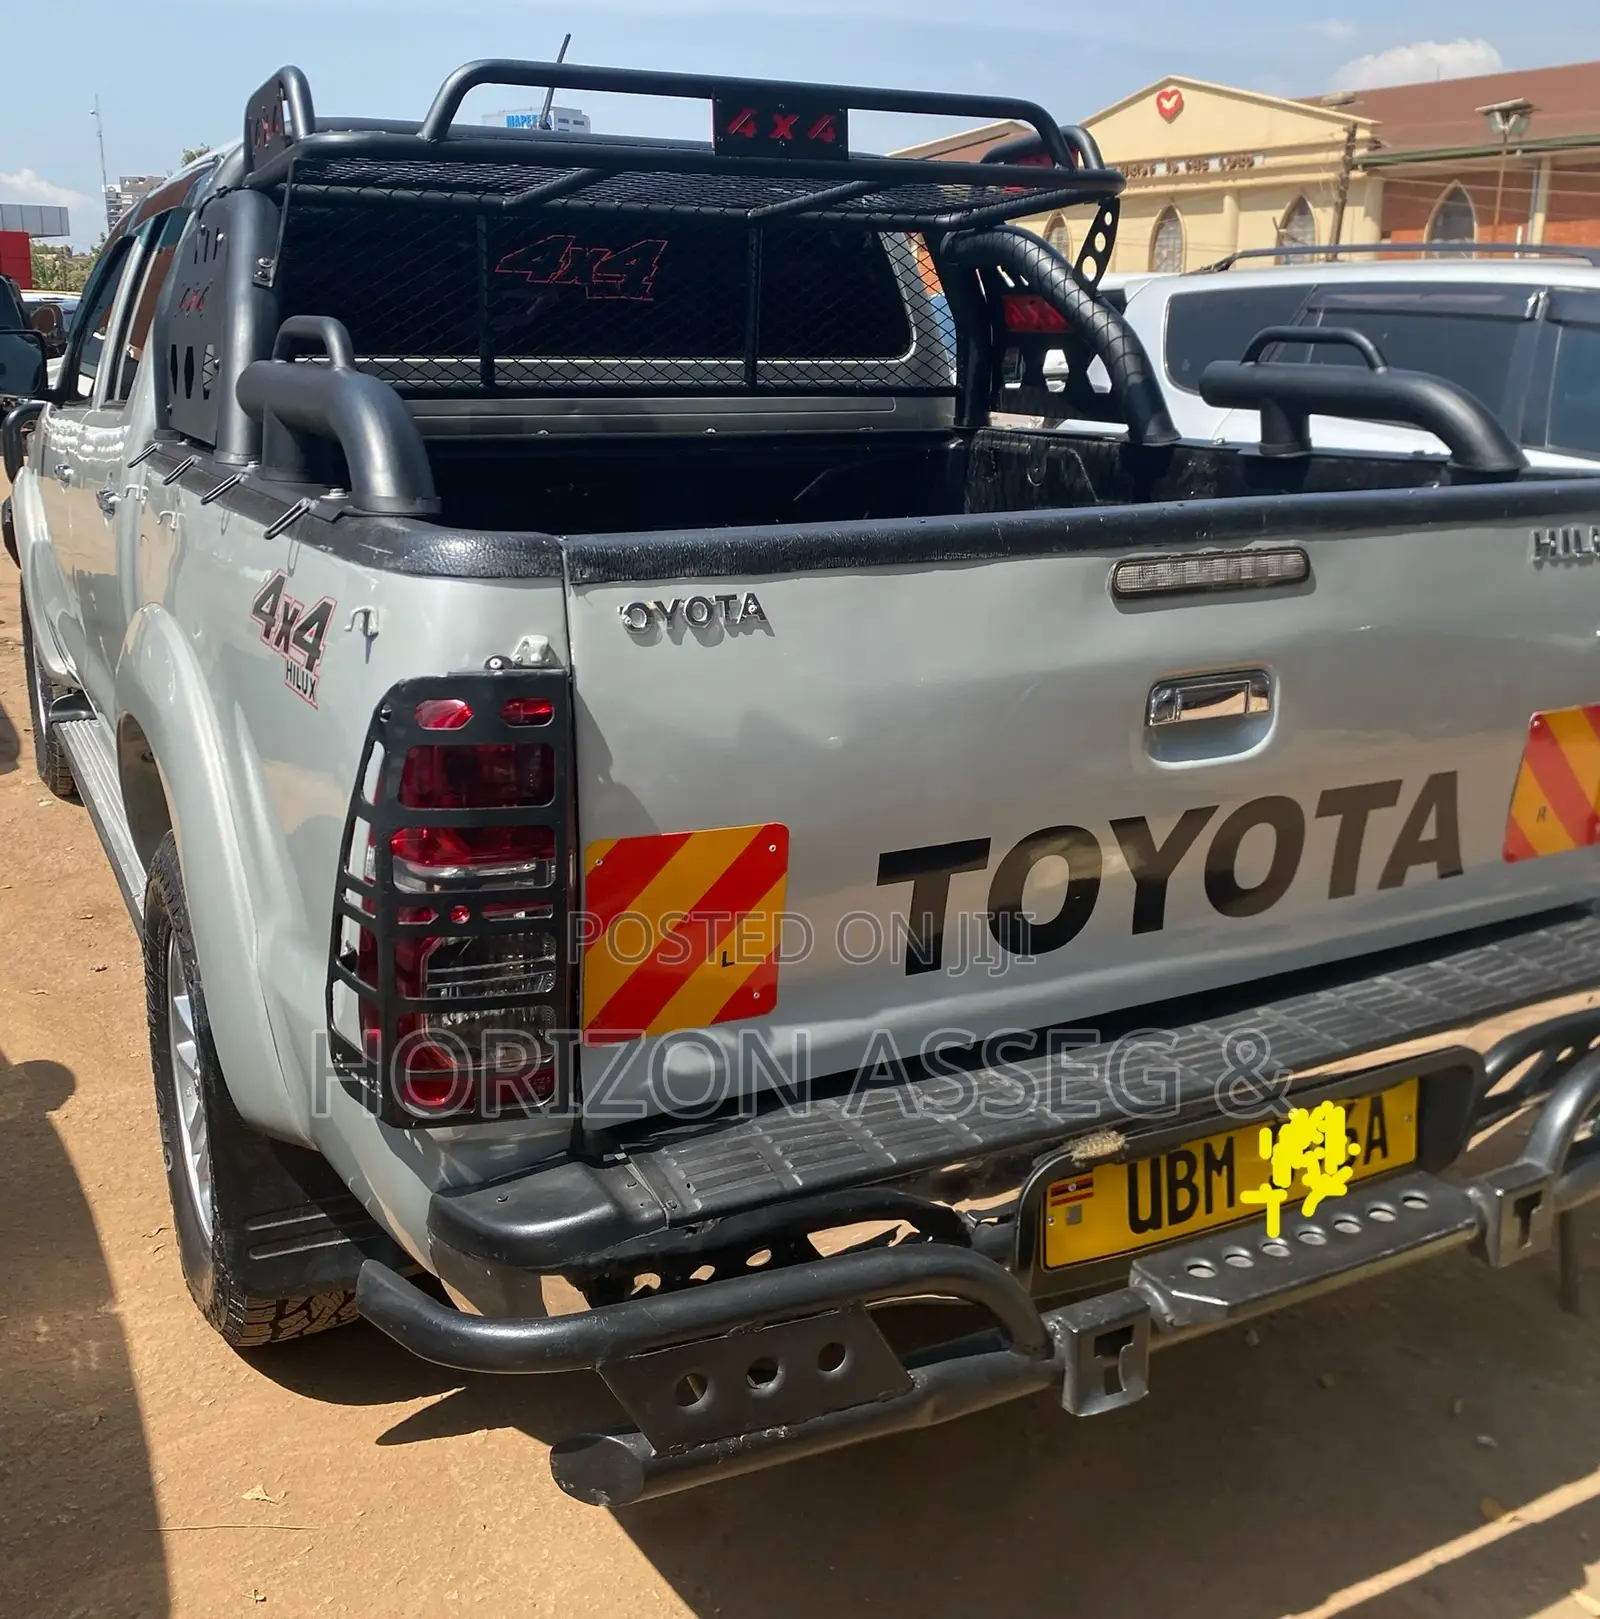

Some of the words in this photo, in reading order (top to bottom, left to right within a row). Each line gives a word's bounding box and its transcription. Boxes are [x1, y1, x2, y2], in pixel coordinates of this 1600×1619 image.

[285, 659, 317, 701] HILUX
[1536, 805, 1547, 823] R
[876, 770, 1464, 977] TOYOTA
[721, 950, 735, 968] L
[1126, 1135, 1237, 1236] UBM
